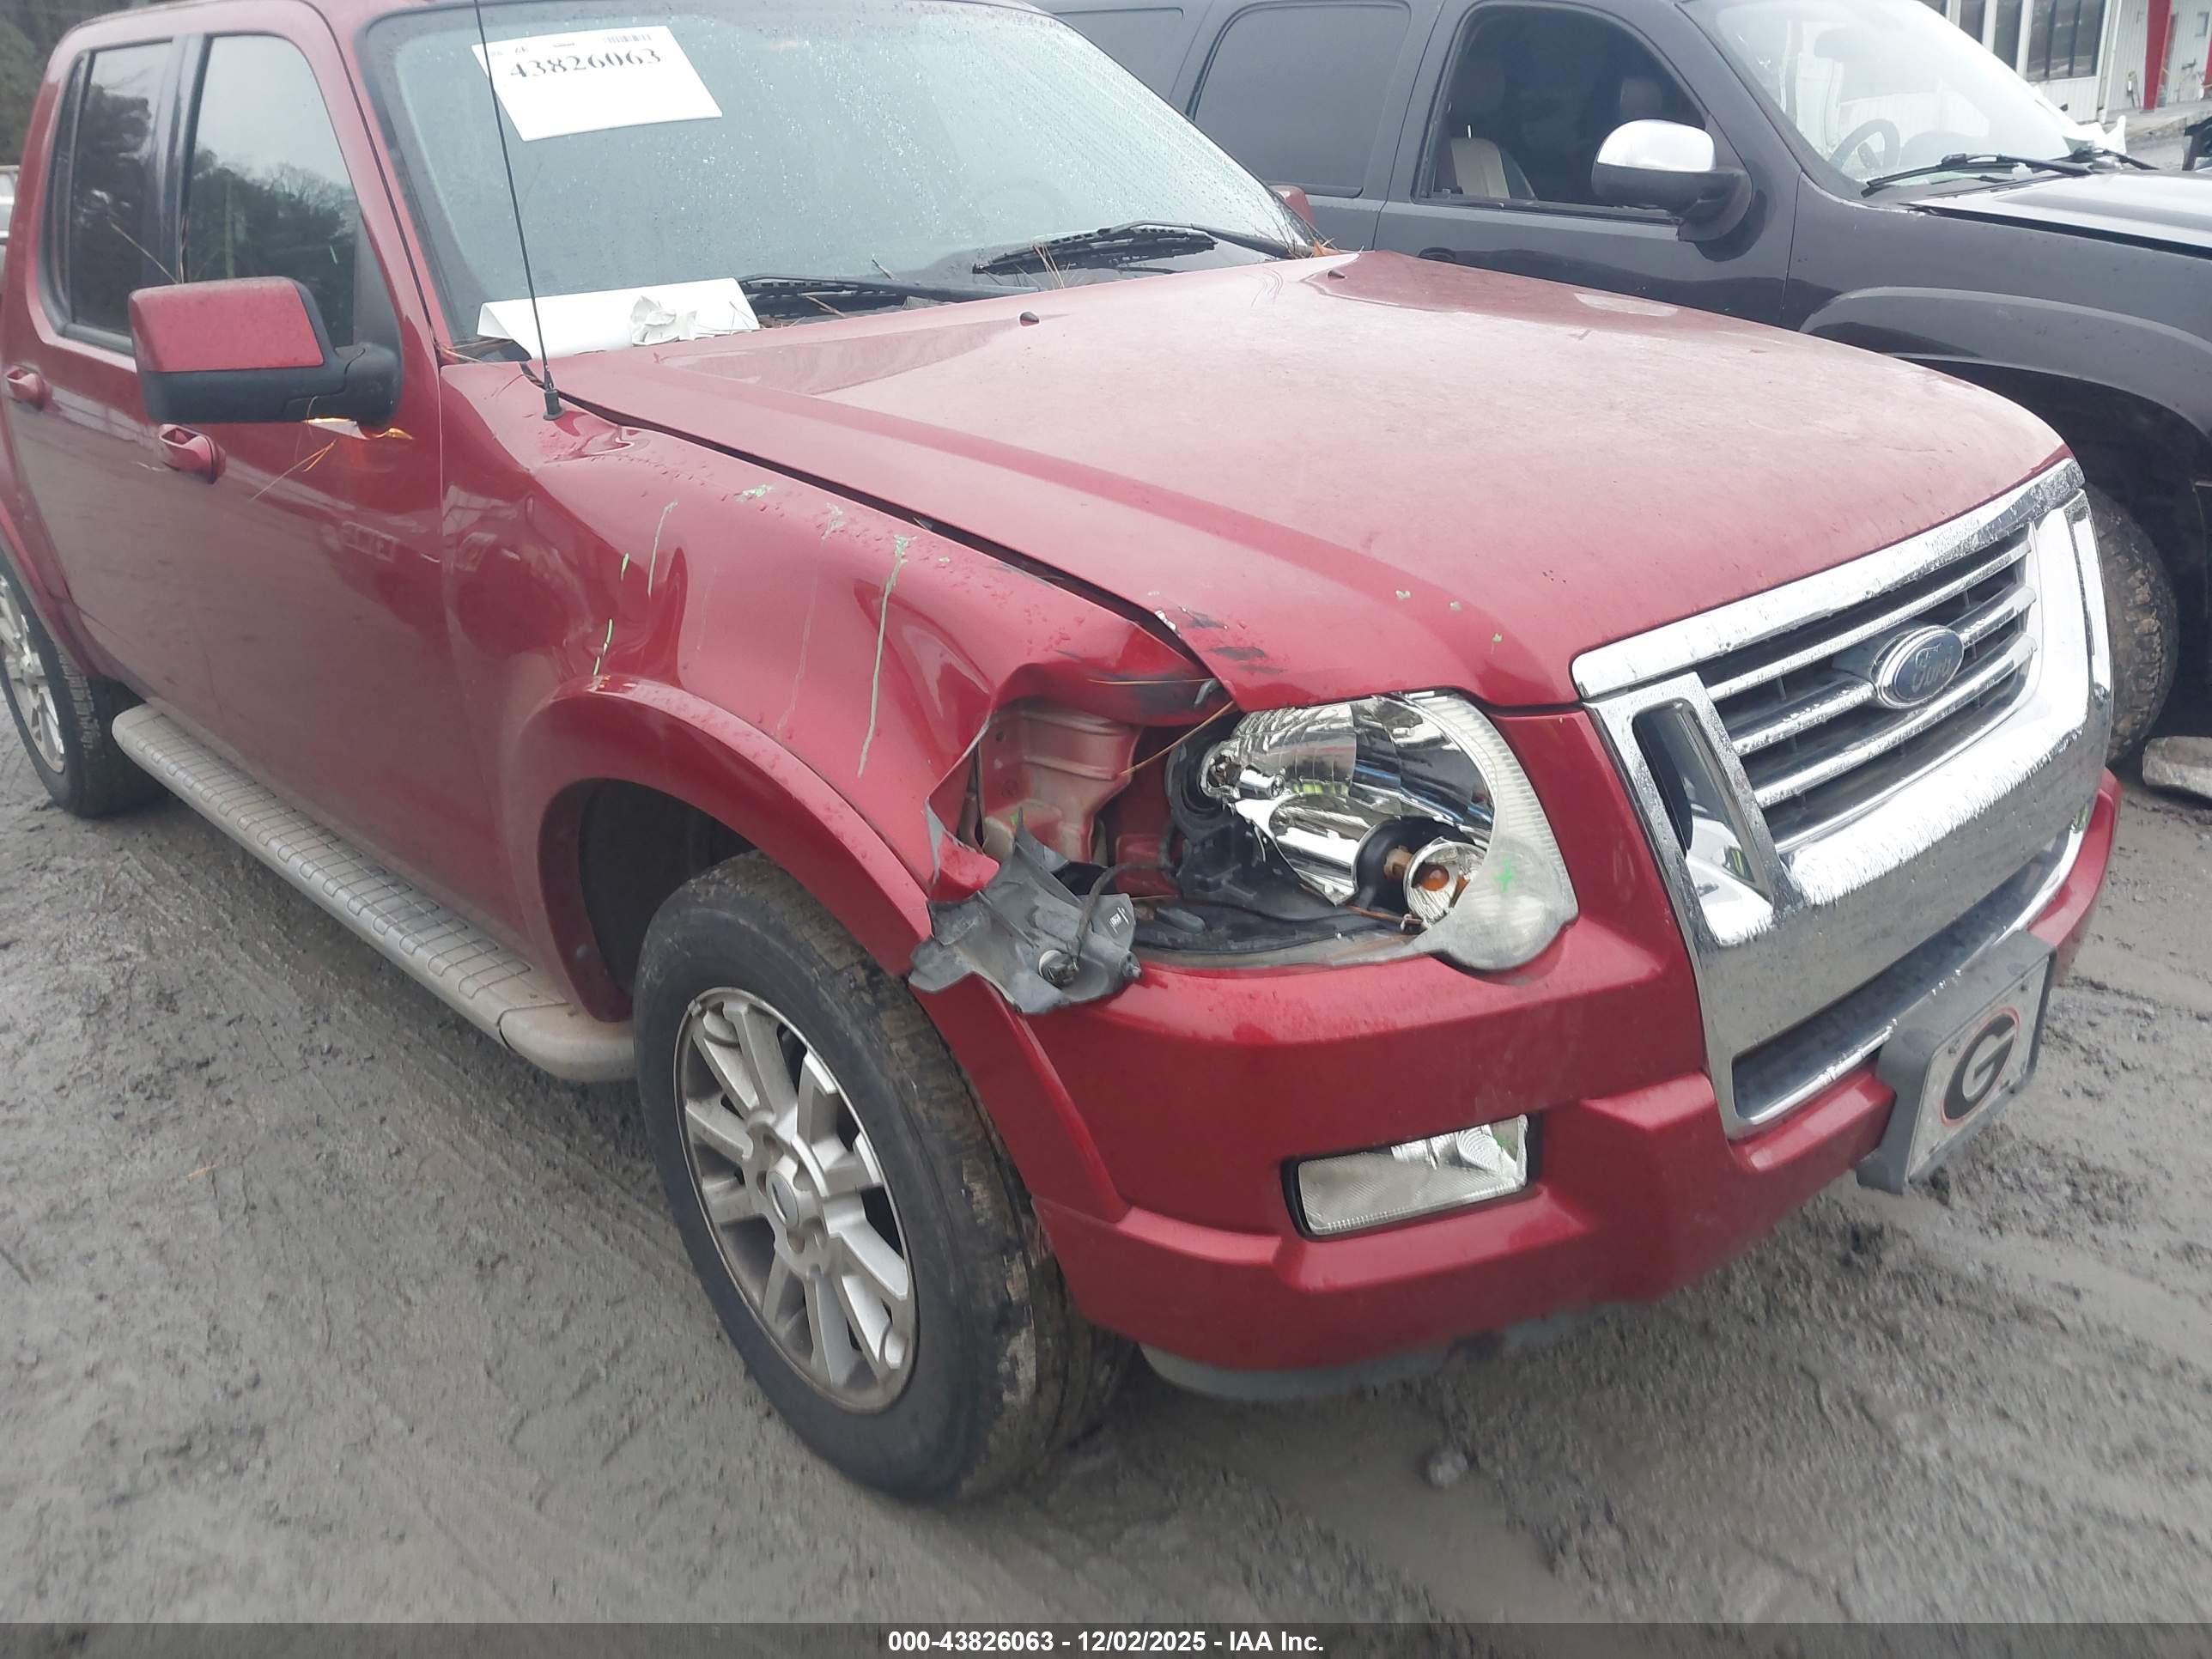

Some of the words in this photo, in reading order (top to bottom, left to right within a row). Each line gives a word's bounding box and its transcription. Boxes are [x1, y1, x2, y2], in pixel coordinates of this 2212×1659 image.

[509, 46, 662, 78] 43826063
[1911, 641, 1954, 693] Ford
[1942, 1012, 2017, 1121] G
